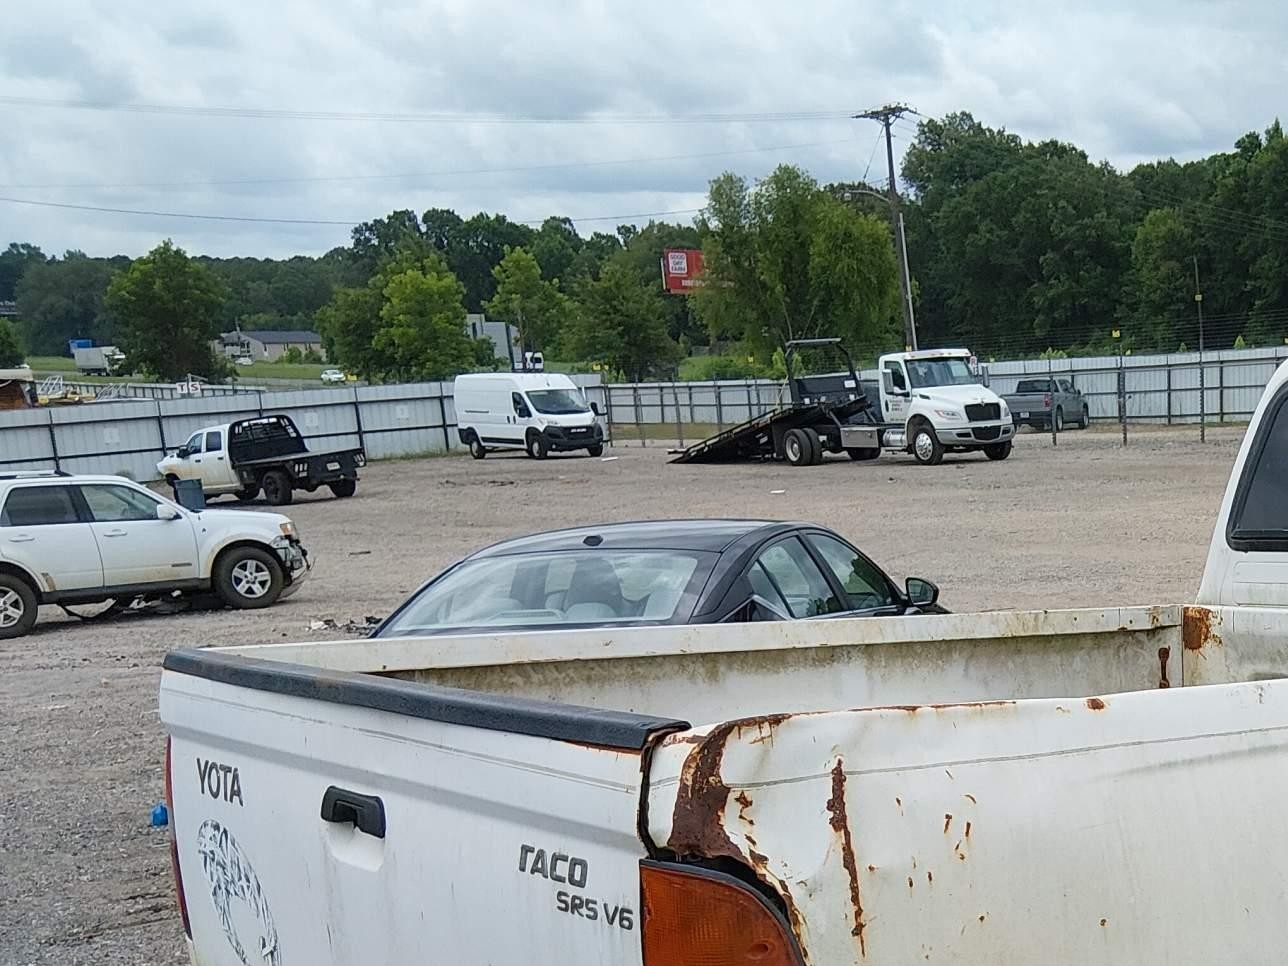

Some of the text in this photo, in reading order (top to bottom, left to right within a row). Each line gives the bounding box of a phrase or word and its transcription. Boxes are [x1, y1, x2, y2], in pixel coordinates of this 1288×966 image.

[178, 384, 186, 393] T
[196, 757, 244, 807] YOTA
[518, 843, 588, 889] TACO
[556, 890, 634, 931] SR5 V6
